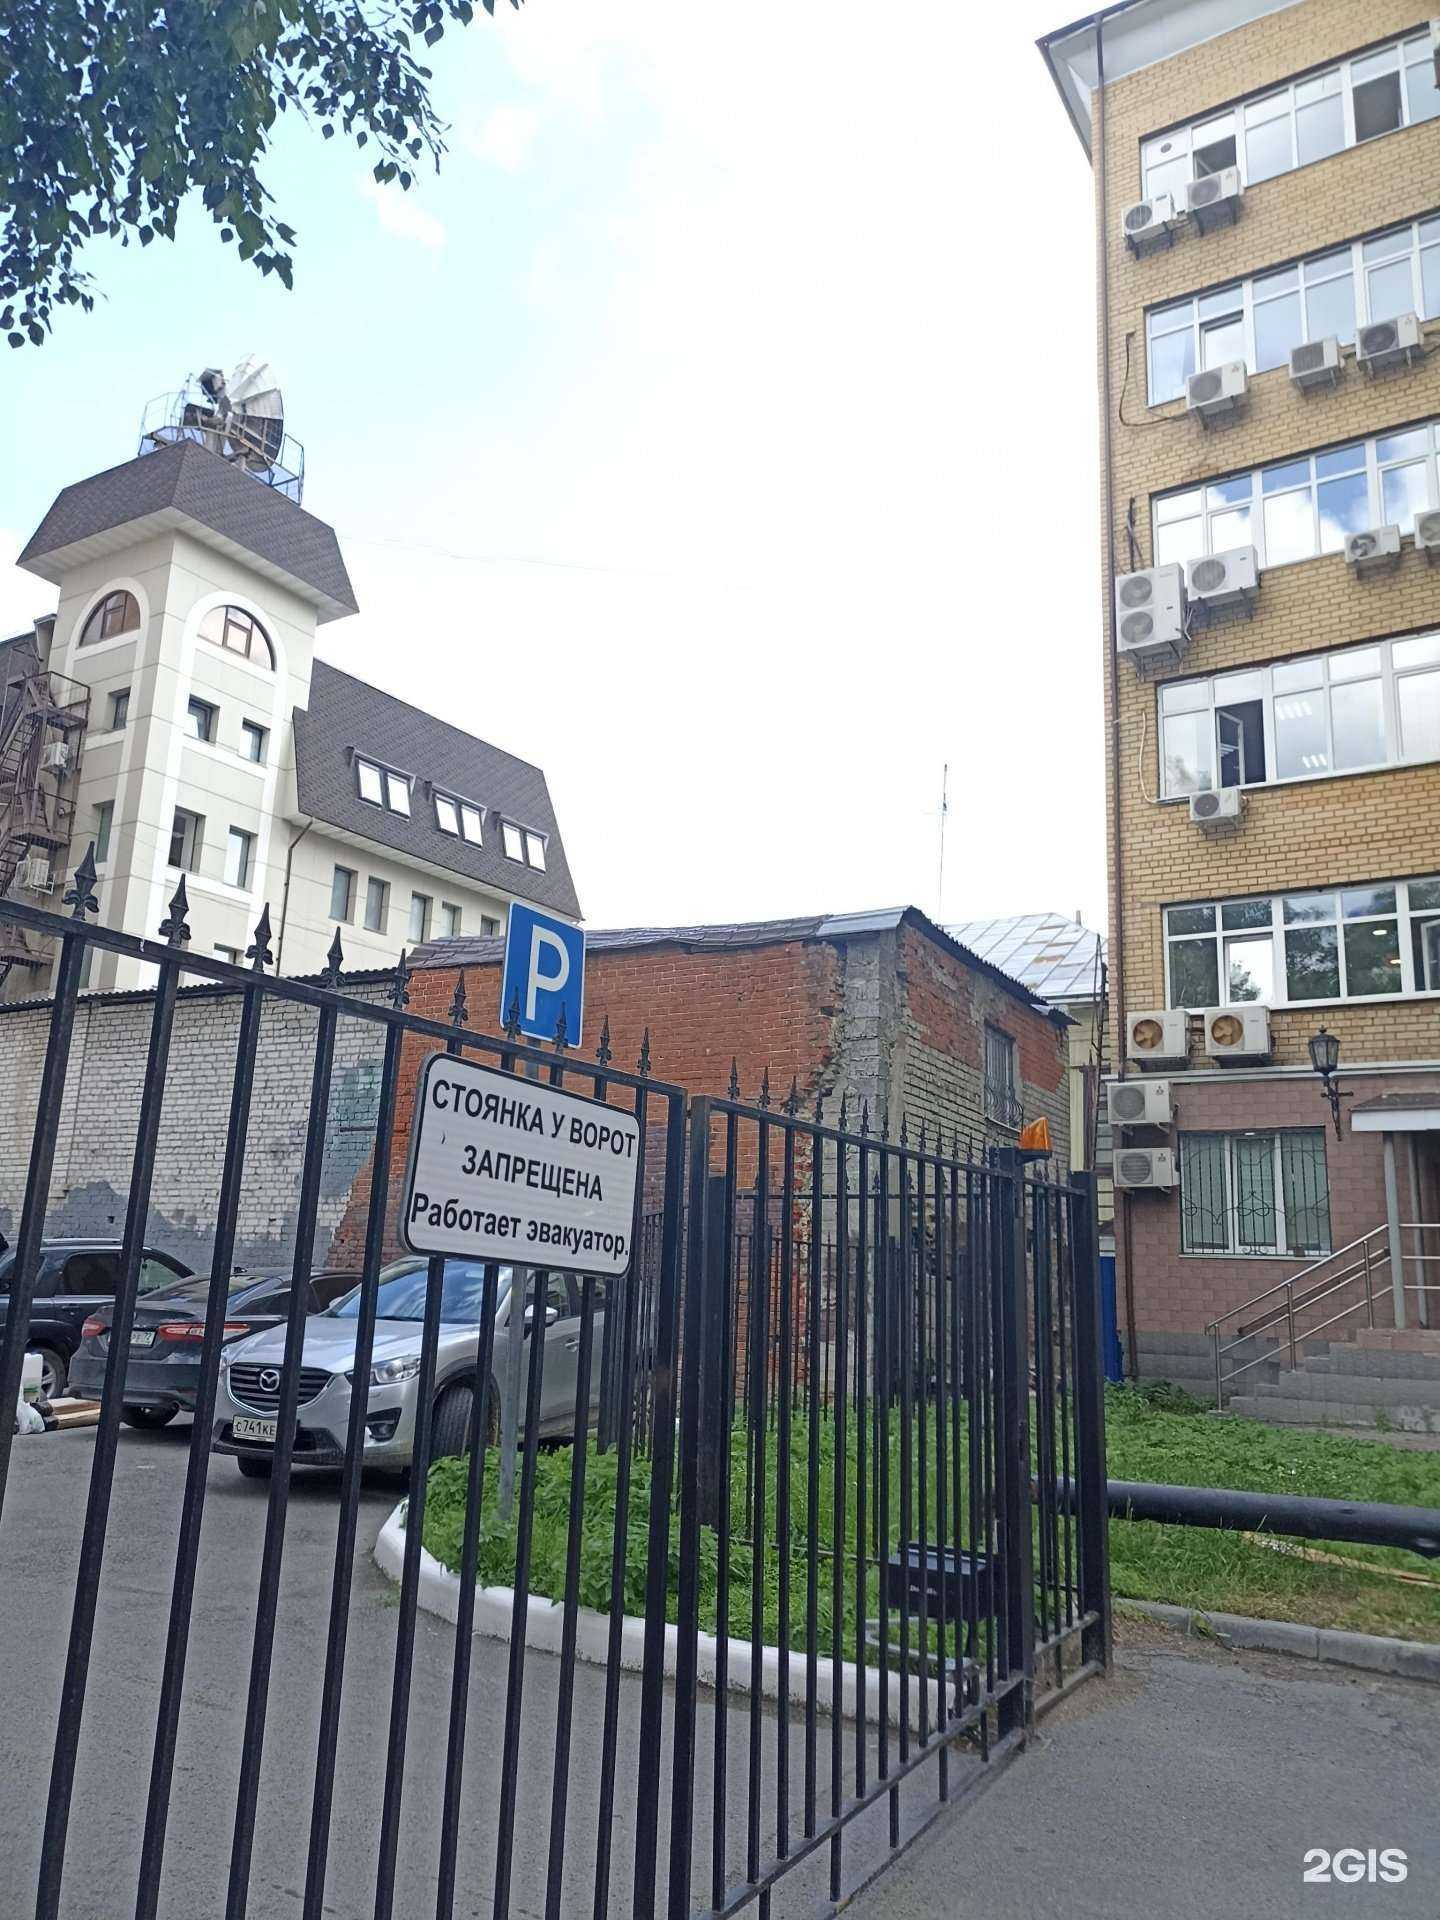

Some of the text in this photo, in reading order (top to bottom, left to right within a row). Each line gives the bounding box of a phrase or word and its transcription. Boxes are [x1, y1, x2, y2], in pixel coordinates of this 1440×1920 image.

[525, 924, 570, 1021] P
[432, 1079, 636, 1158] СТОЯНКА У ВОРОТ
[461, 1145, 603, 1201] ЗАПРЕЩЕНА
[411, 1192, 629, 1260] Работает эвакуатор.
